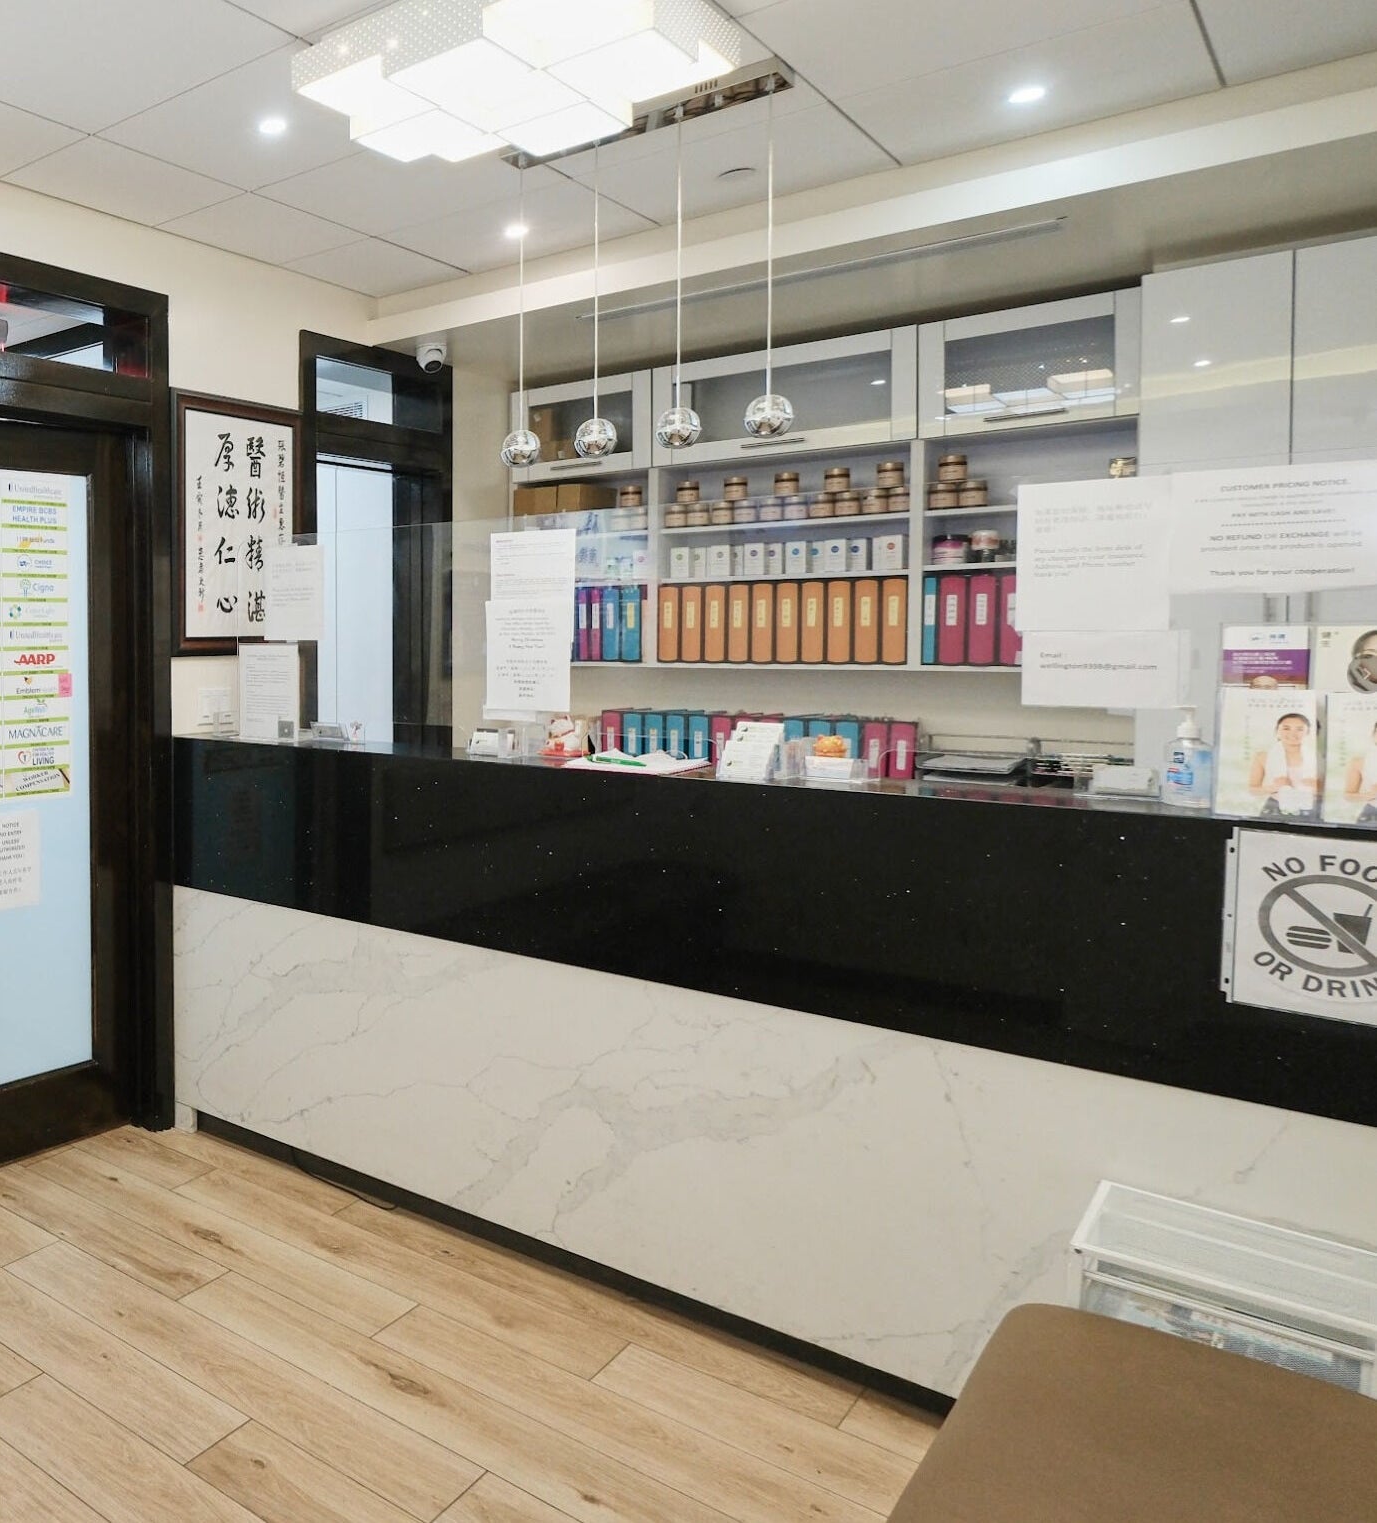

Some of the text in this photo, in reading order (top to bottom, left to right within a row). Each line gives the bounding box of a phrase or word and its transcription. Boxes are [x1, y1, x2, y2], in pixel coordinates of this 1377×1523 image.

[1226, 533, 1263, 541] REFUND
[14, 653, 56, 665] AARP
[32, 756, 55, 766] LIVING
[1261, 857, 1305, 881] NO
[1253, 951, 1293, 981] OR
